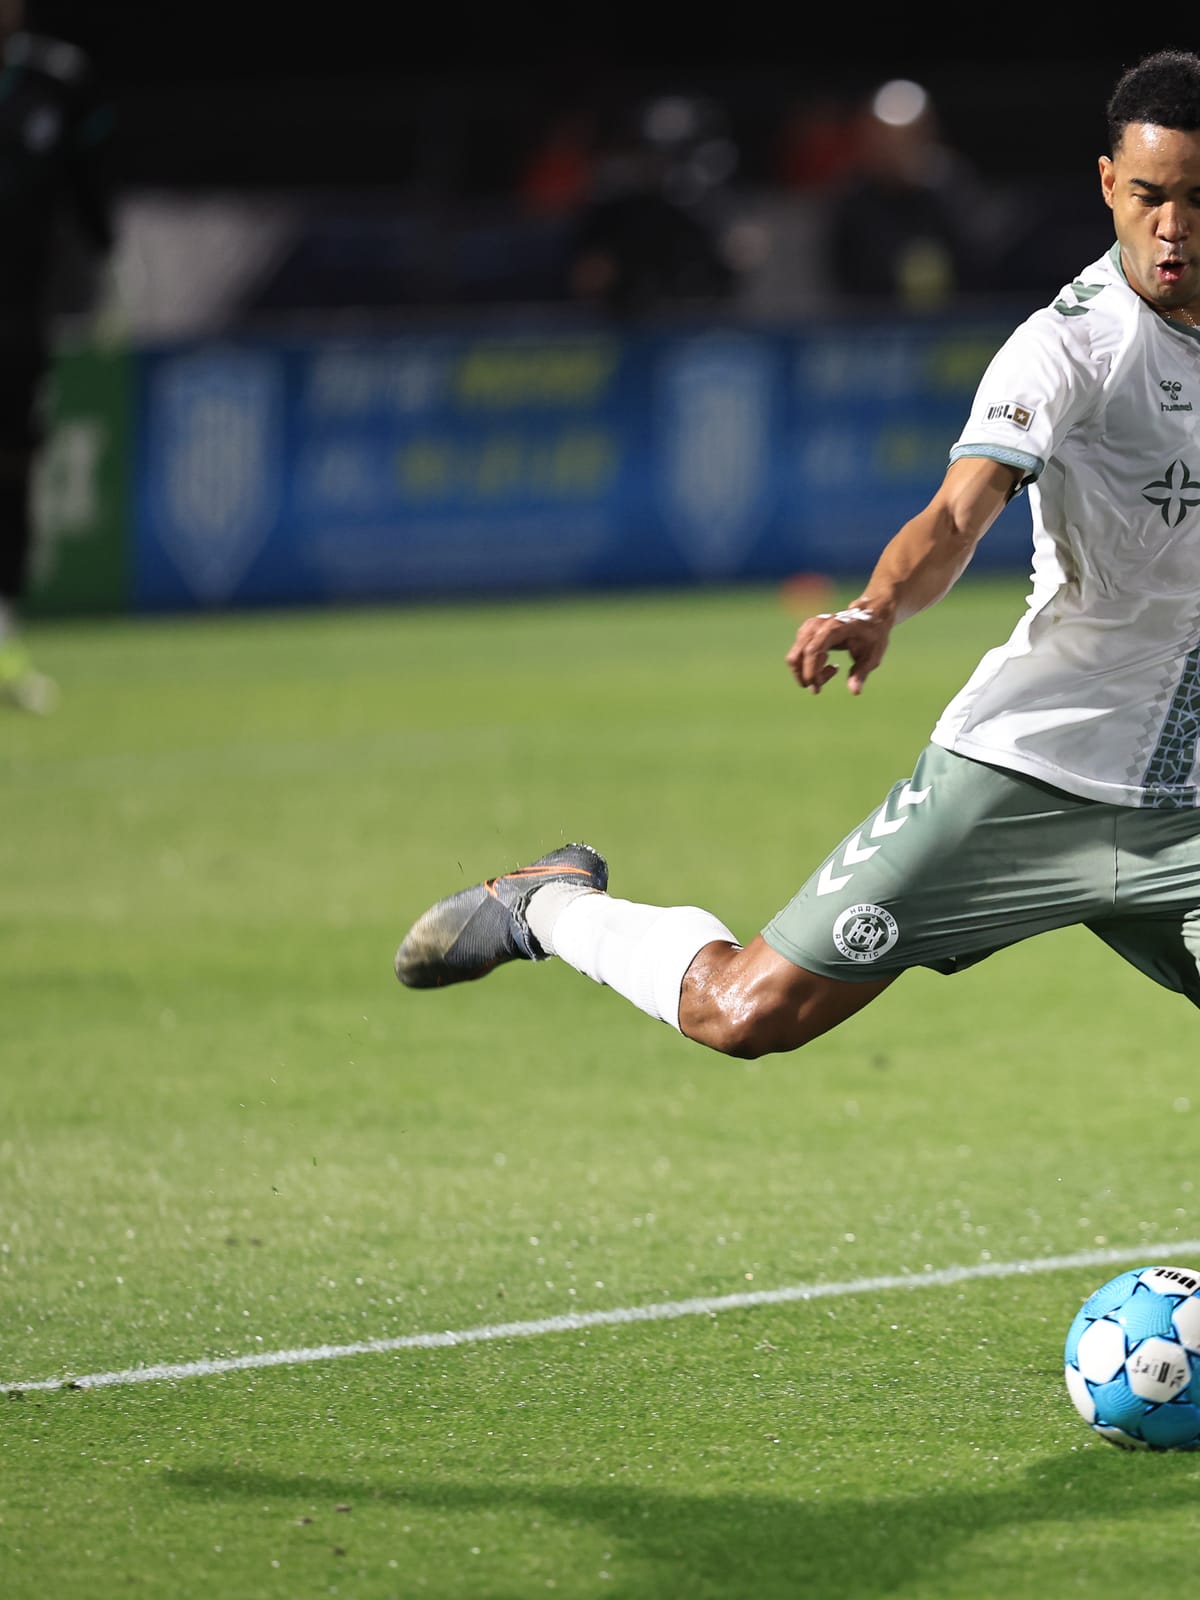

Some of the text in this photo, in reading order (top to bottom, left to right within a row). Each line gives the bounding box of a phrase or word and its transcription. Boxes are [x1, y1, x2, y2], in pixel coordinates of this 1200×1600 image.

[1160, 402, 1192, 412] hummel
[850, 905, 897, 936] HARTFORD
[835, 933, 880, 960] ATHLETIC
